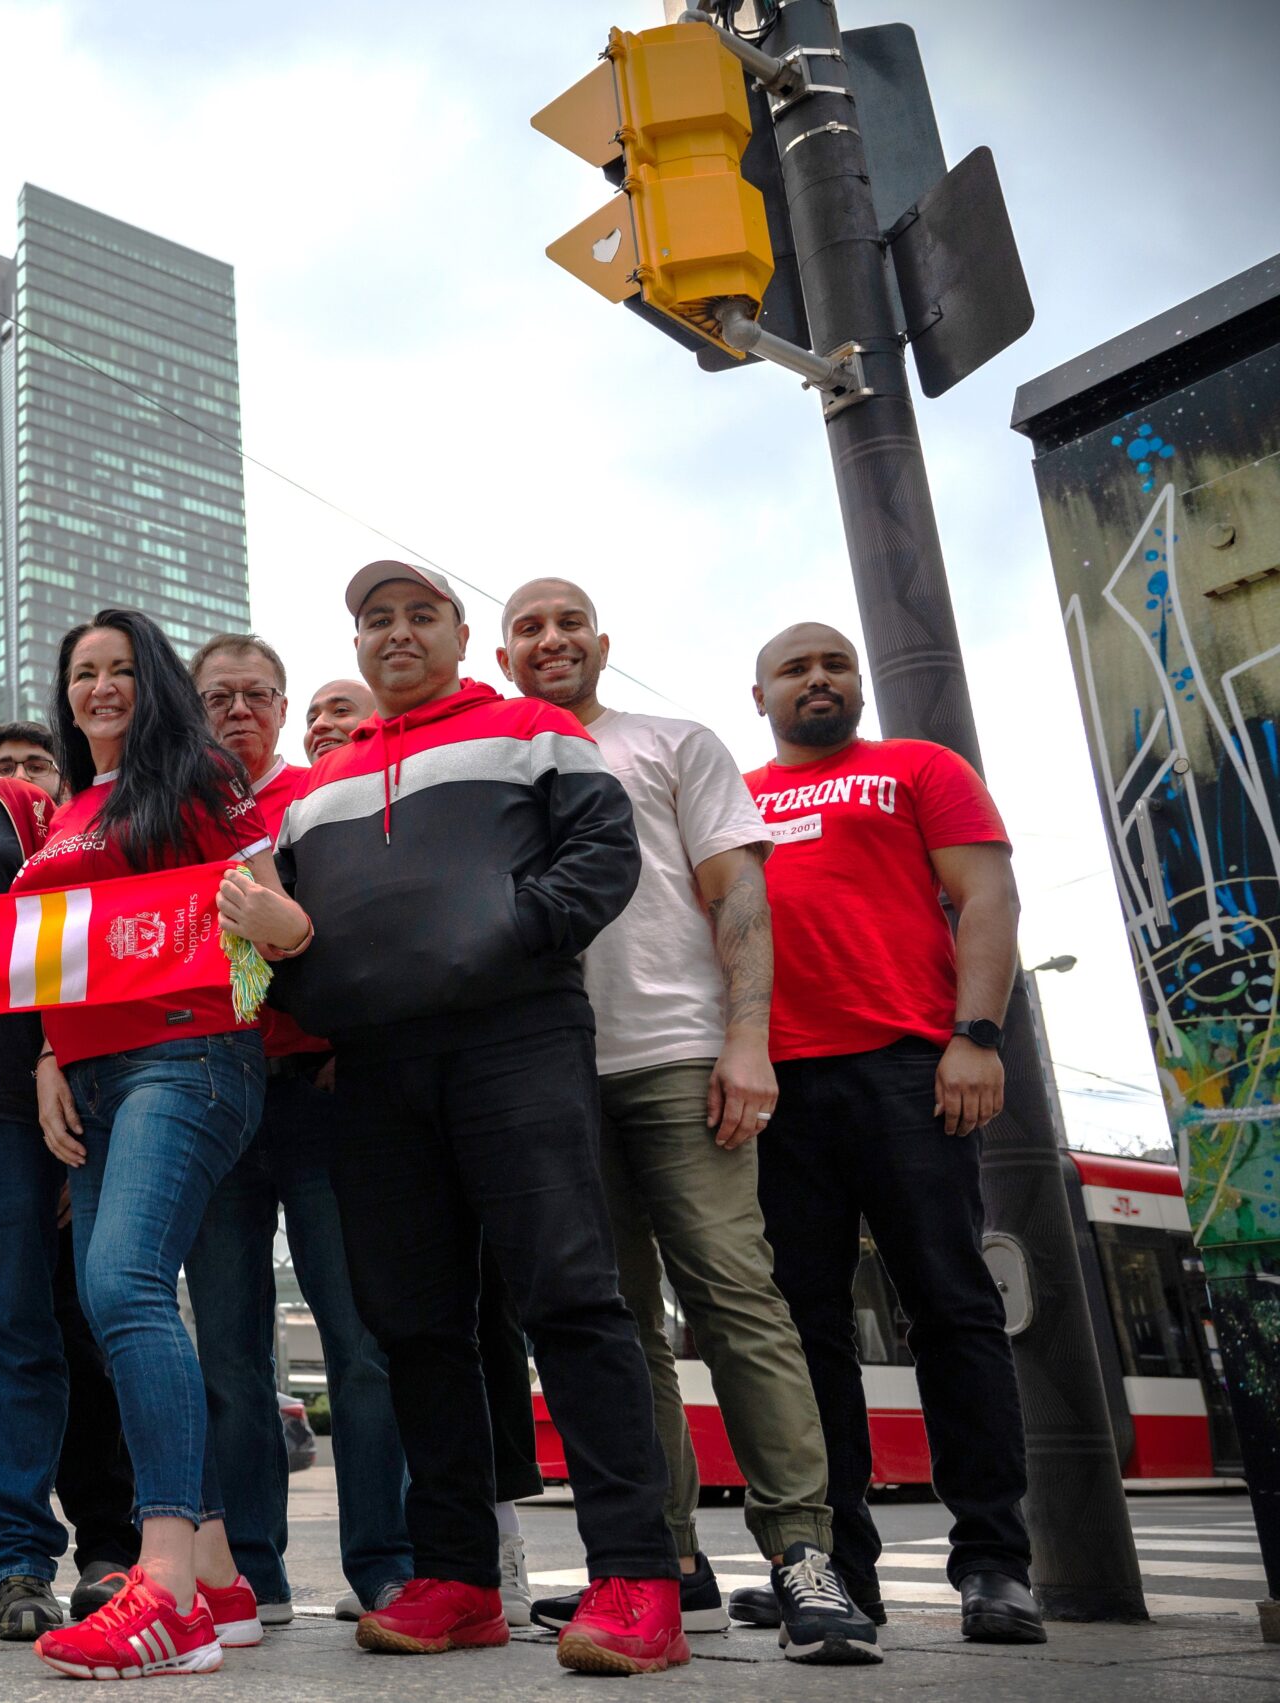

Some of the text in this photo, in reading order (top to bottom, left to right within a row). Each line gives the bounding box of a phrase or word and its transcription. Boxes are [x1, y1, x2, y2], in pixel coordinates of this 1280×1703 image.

[755, 775, 897, 814] TORONTO
[791, 822, 816, 835] 2001
[173, 908, 185, 953] Official
[184, 893, 198, 964] Supporters
[200, 913, 212, 942] Club
